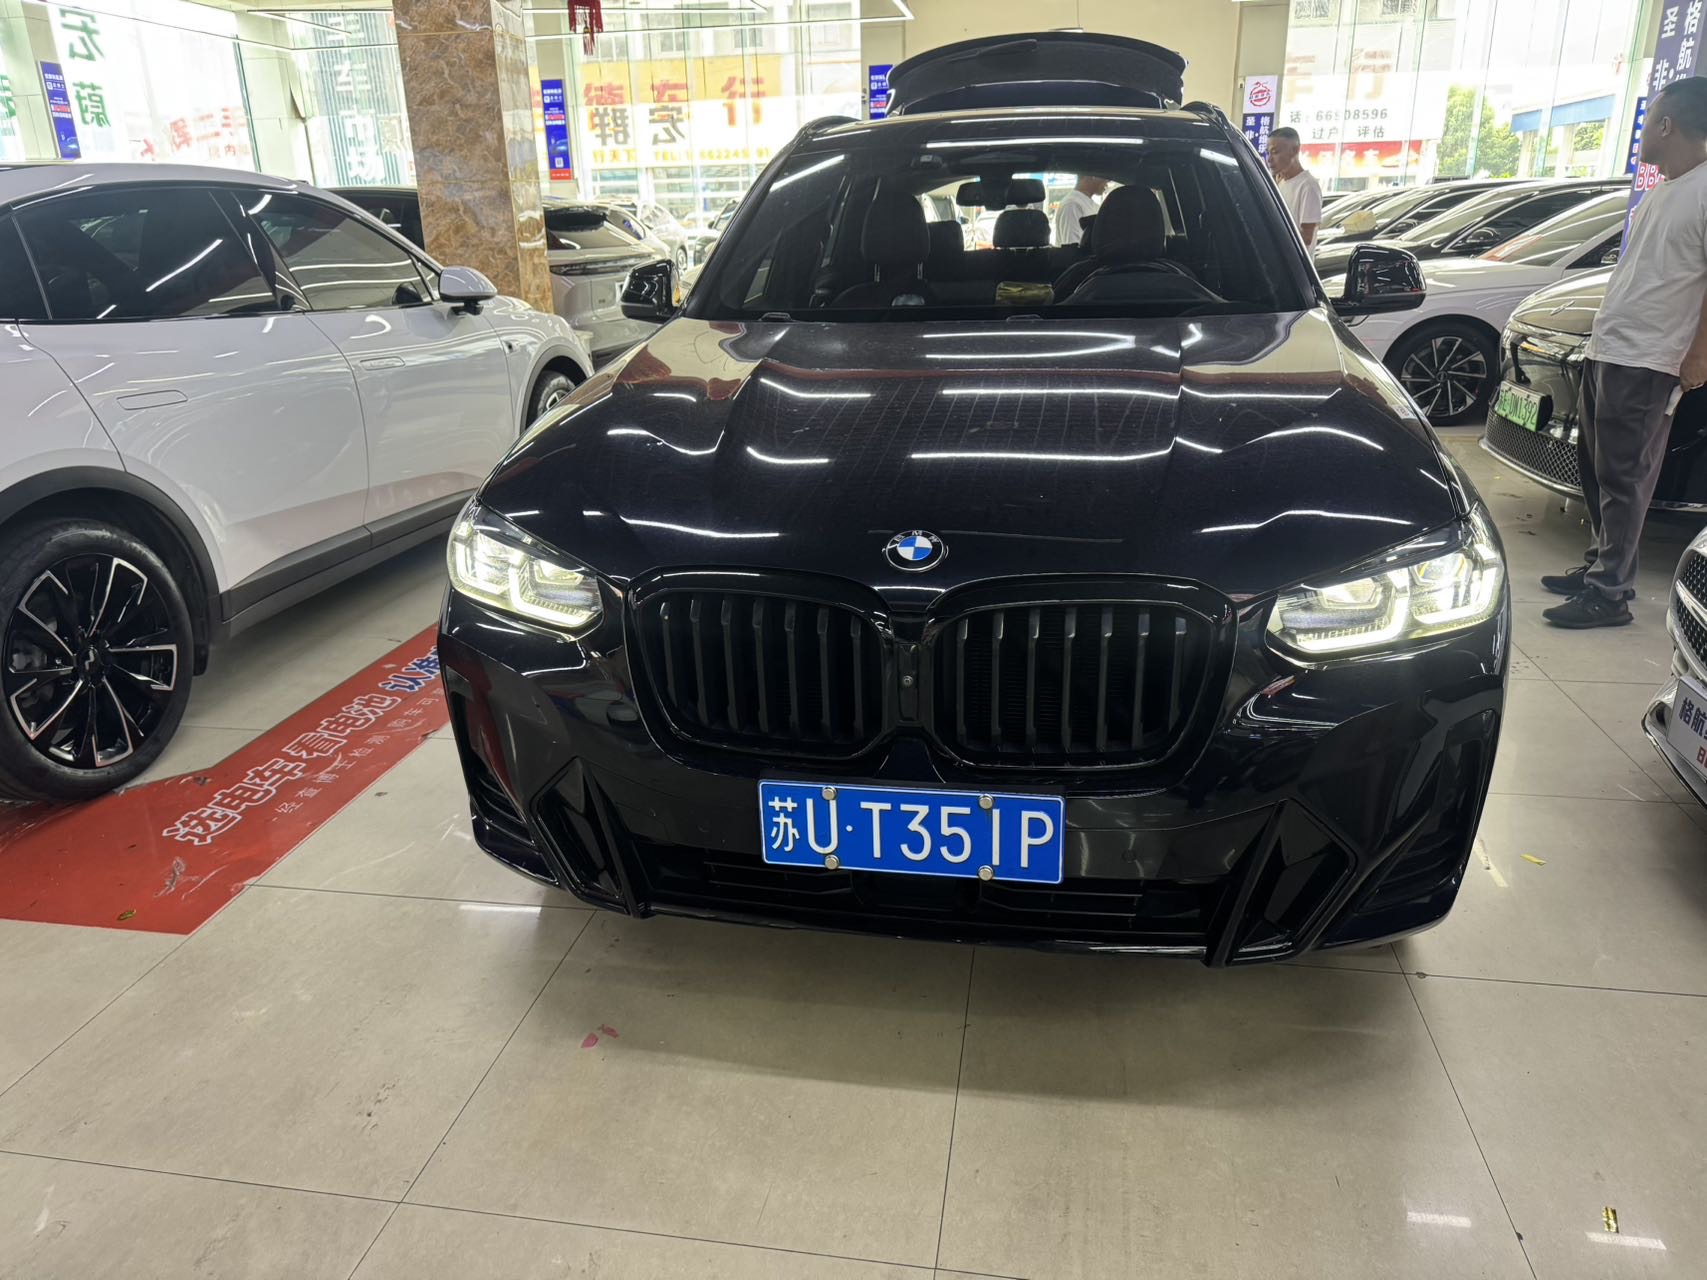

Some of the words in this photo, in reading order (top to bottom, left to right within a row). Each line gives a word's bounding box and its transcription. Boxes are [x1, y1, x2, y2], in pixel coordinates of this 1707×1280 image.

[1357, 125, 1385, 139] 评估
[1679, 697, 1707, 740] 格航
[768, 797, 1054, 868] 苏U·T351P
